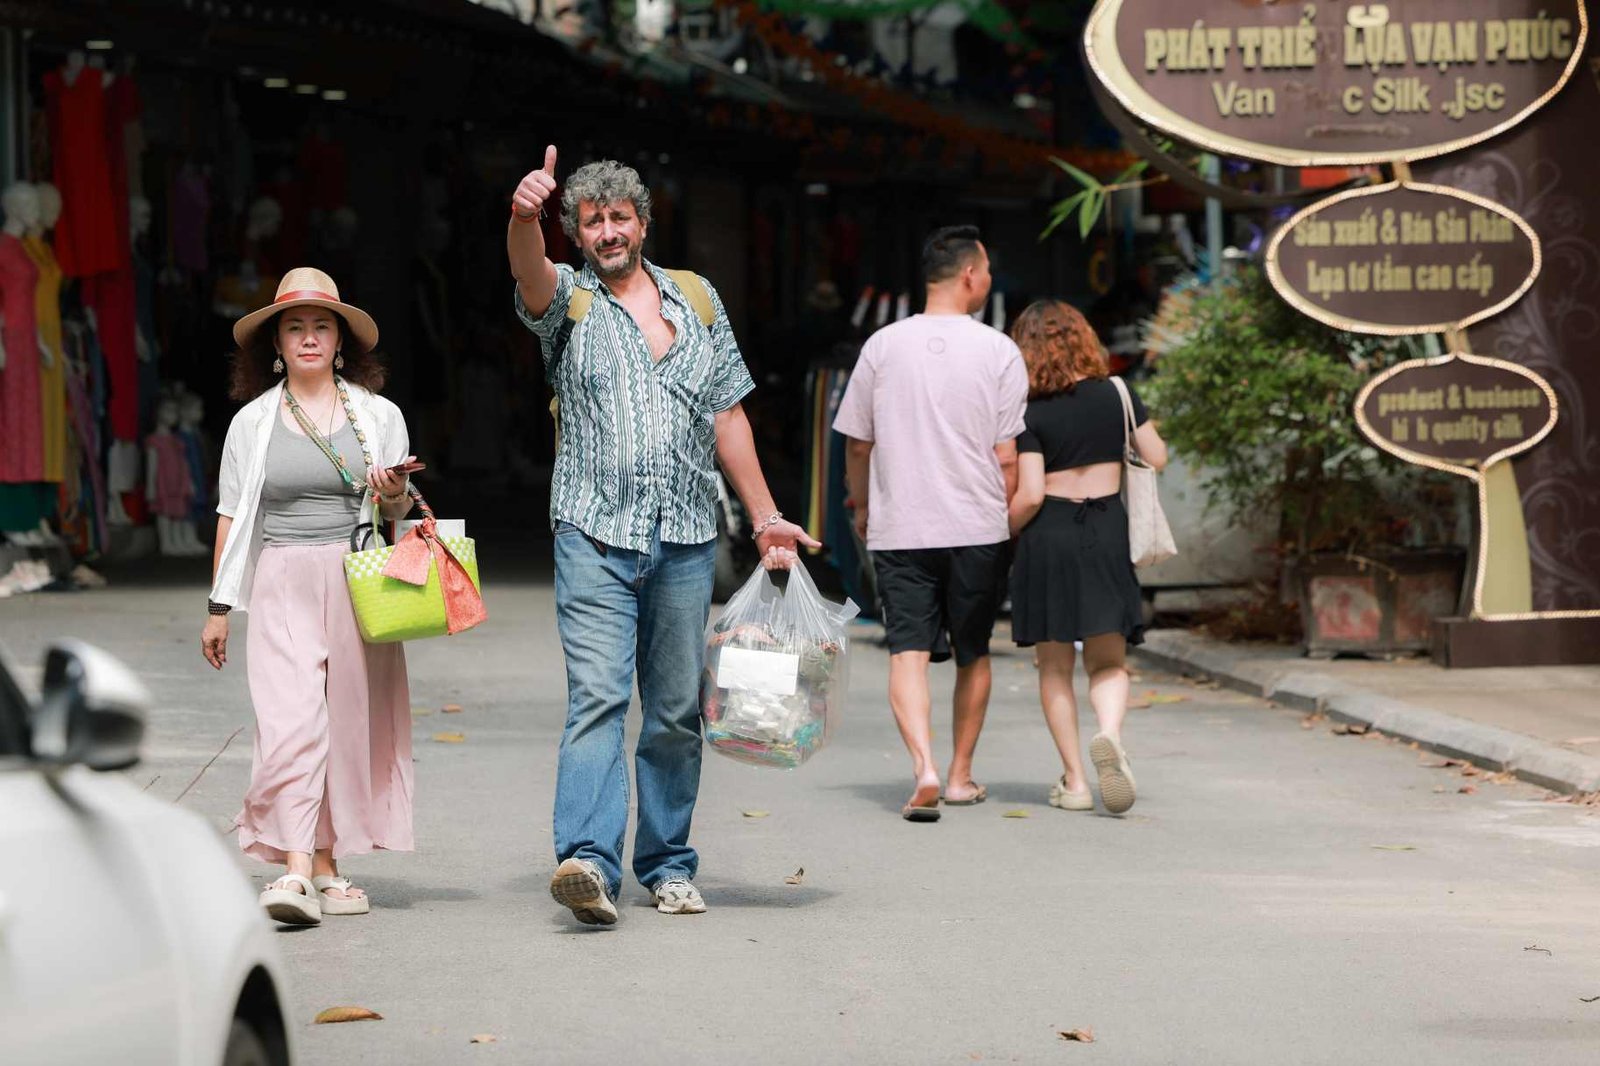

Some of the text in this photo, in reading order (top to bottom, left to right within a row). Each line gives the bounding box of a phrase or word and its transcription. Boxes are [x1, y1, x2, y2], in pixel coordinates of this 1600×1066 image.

[1144, 19, 1231, 71] PHÁT
[1411, 20, 1478, 73] VẠN
[1485, 9, 1572, 62] PHÚC
[1212, 80, 1276, 117] Van
[1371, 76, 1431, 114] Silk
[1381, 207, 1399, 245] &
[1415, 264, 1452, 291] cao
[1456, 251, 1494, 297] cấp
[1378, 387, 1444, 418] product
[1447, 383, 1462, 409] &
